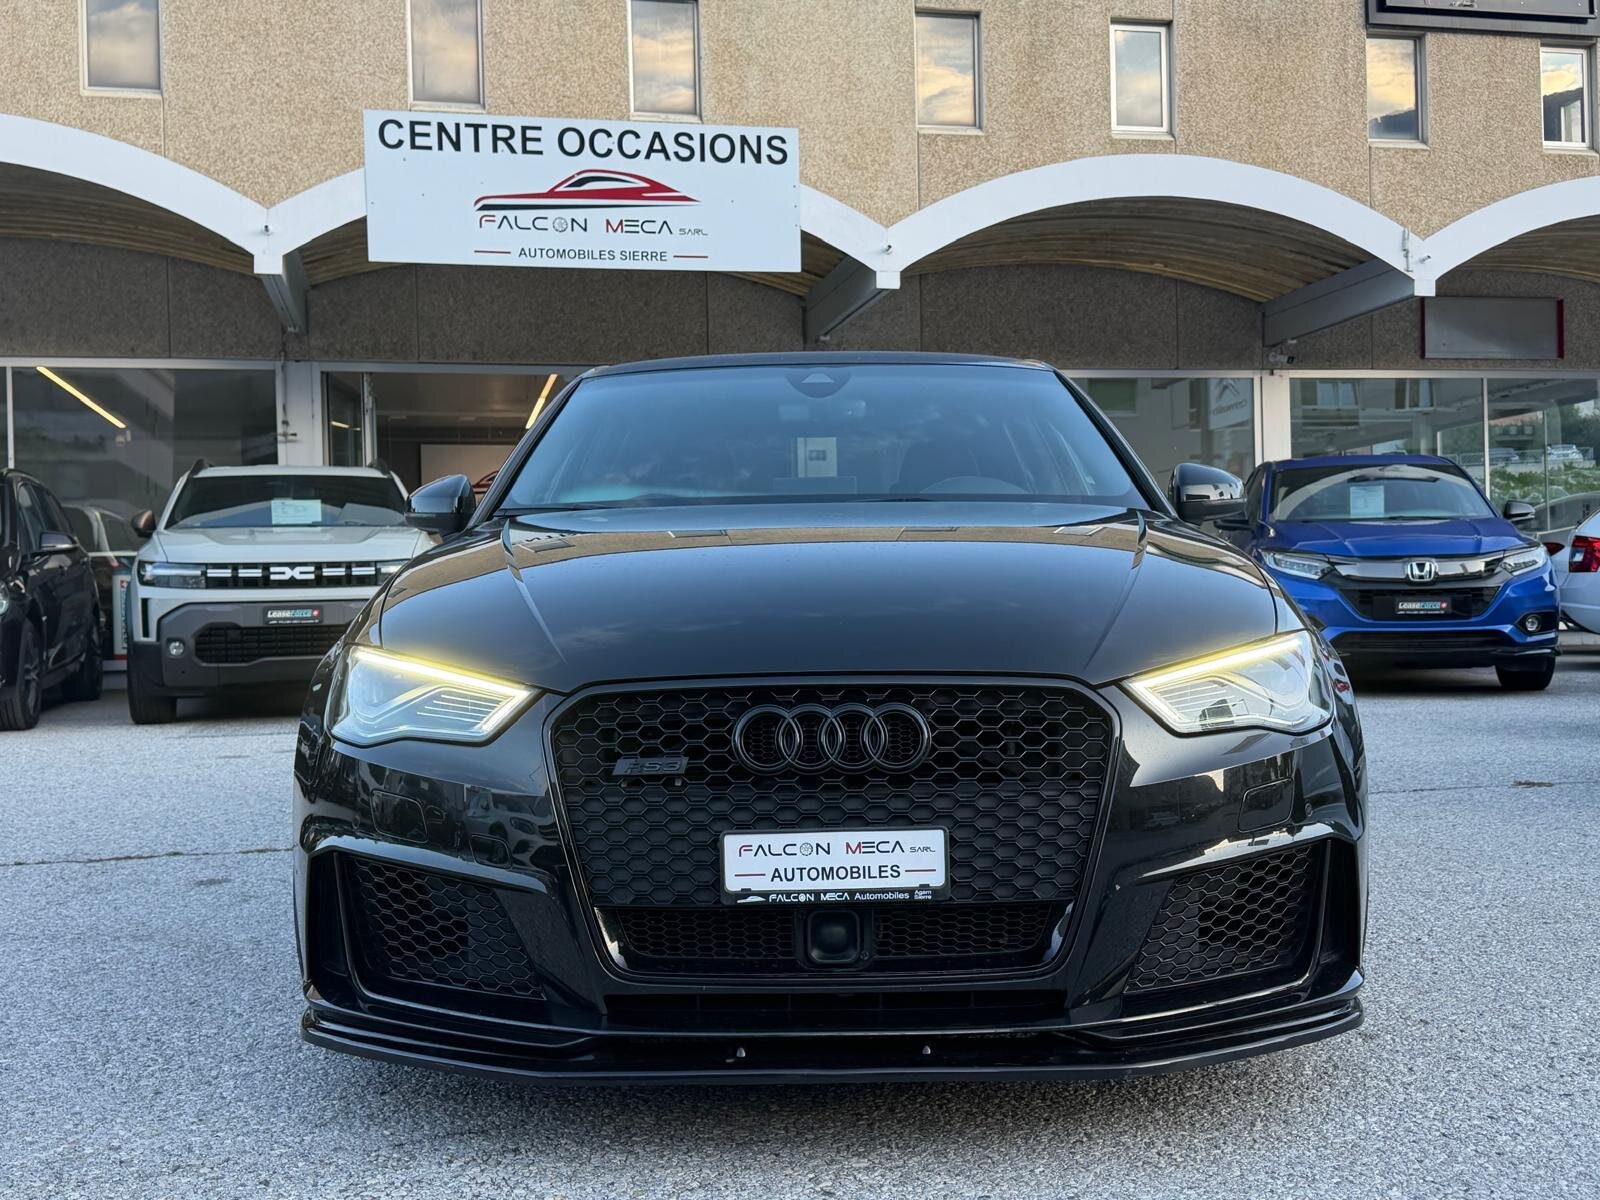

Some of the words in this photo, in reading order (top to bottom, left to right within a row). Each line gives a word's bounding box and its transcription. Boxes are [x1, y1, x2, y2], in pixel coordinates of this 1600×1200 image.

[378, 118, 543, 156] CENTRE
[557, 127, 788, 165] OCCASIONS
[479, 214, 588, 233] FALCON
[605, 218, 673, 235] MECA
[678, 227, 709, 236] SARL
[518, 247, 616, 261] AUTOMOBILES
[619, 249, 668, 262] SIERRE
[738, 842, 831, 857] FALCON
[845, 840, 905, 854] MECA
[770, 864, 901, 882] AUTOMOBILES
[768, 893, 815, 903] FALCON
[820, 892, 850, 901] MECA
[854, 891, 910, 901] Automobiles
